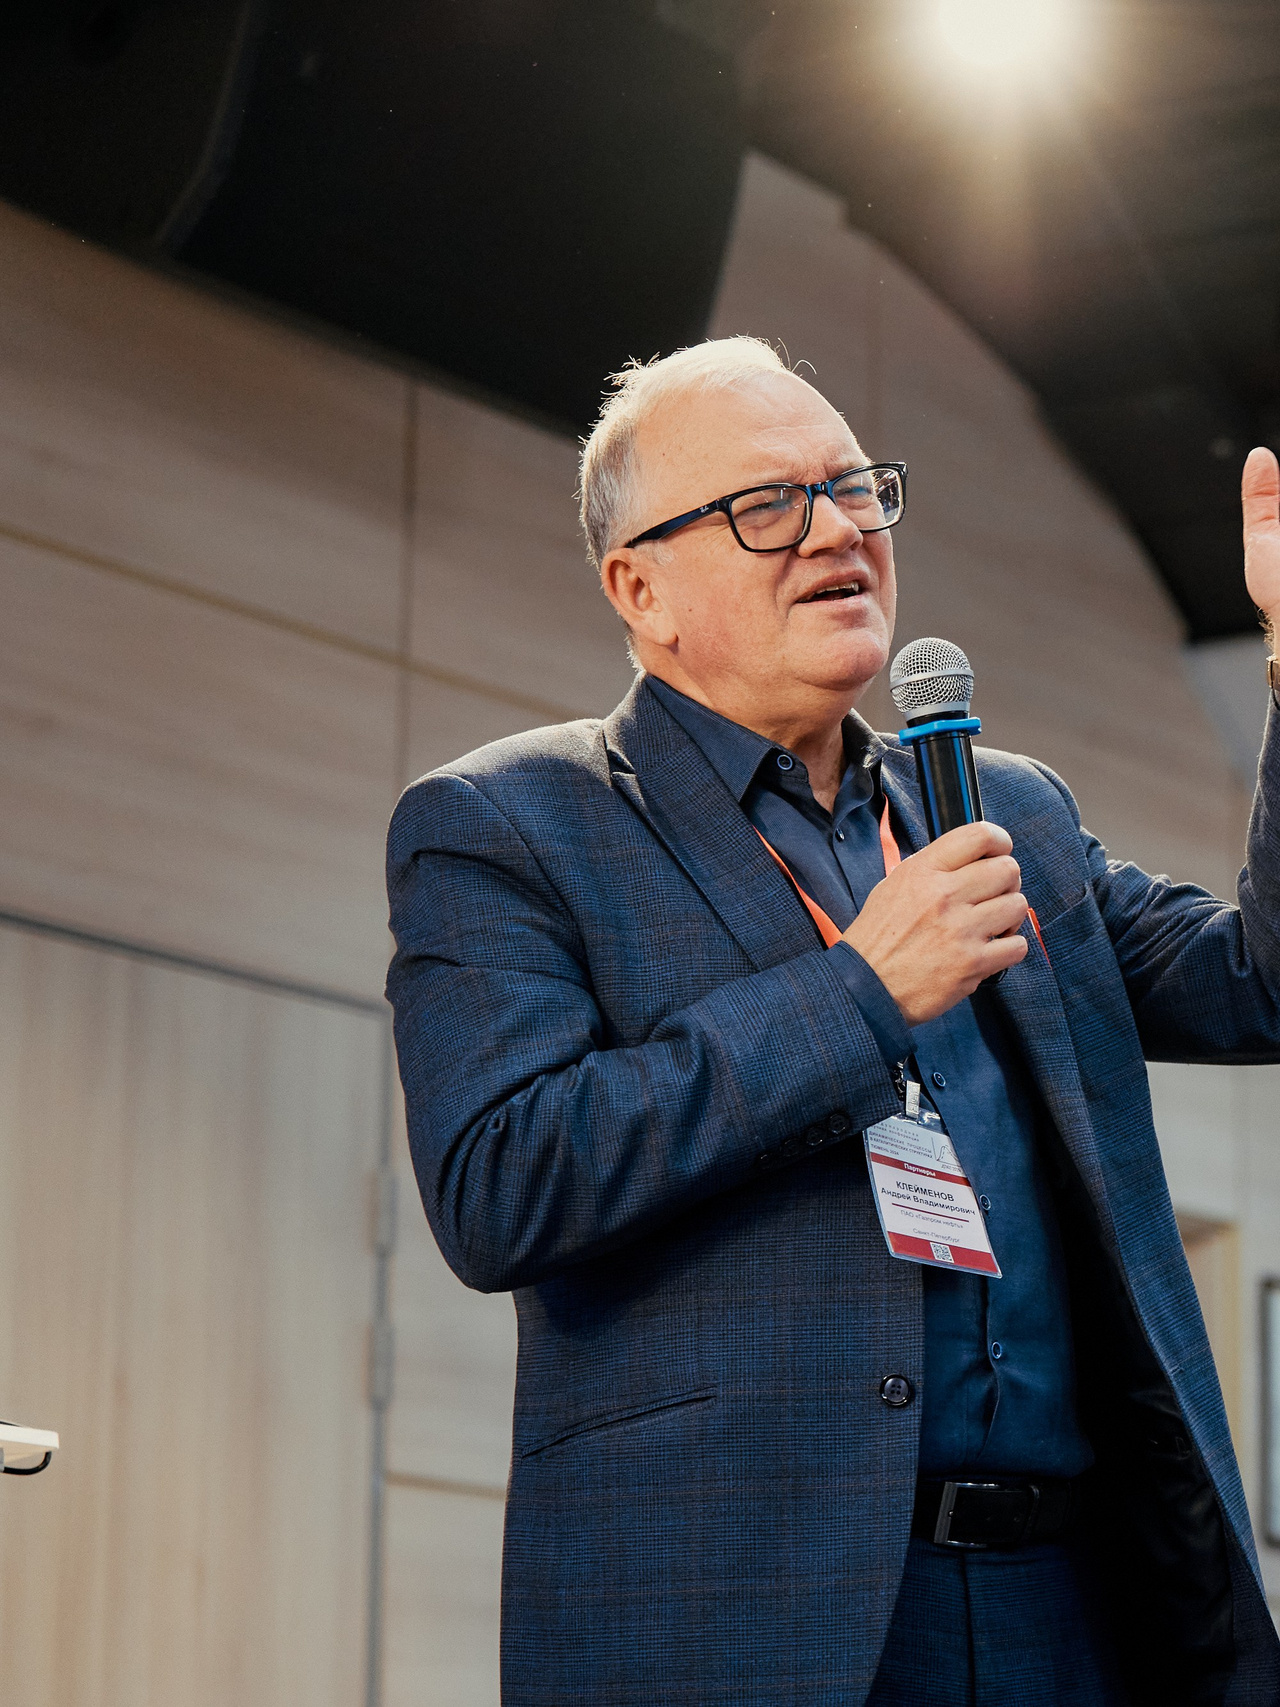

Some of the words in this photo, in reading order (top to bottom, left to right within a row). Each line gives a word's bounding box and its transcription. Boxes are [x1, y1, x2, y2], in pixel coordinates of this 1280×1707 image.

[881, 1187, 912, 1201] Андрей
[913, 1196, 976, 1215] Владимирович
[896, 1181, 955, 1202] КЛЕЙМЕНОВ
[900, 1210, 915, 1218] ПАО
